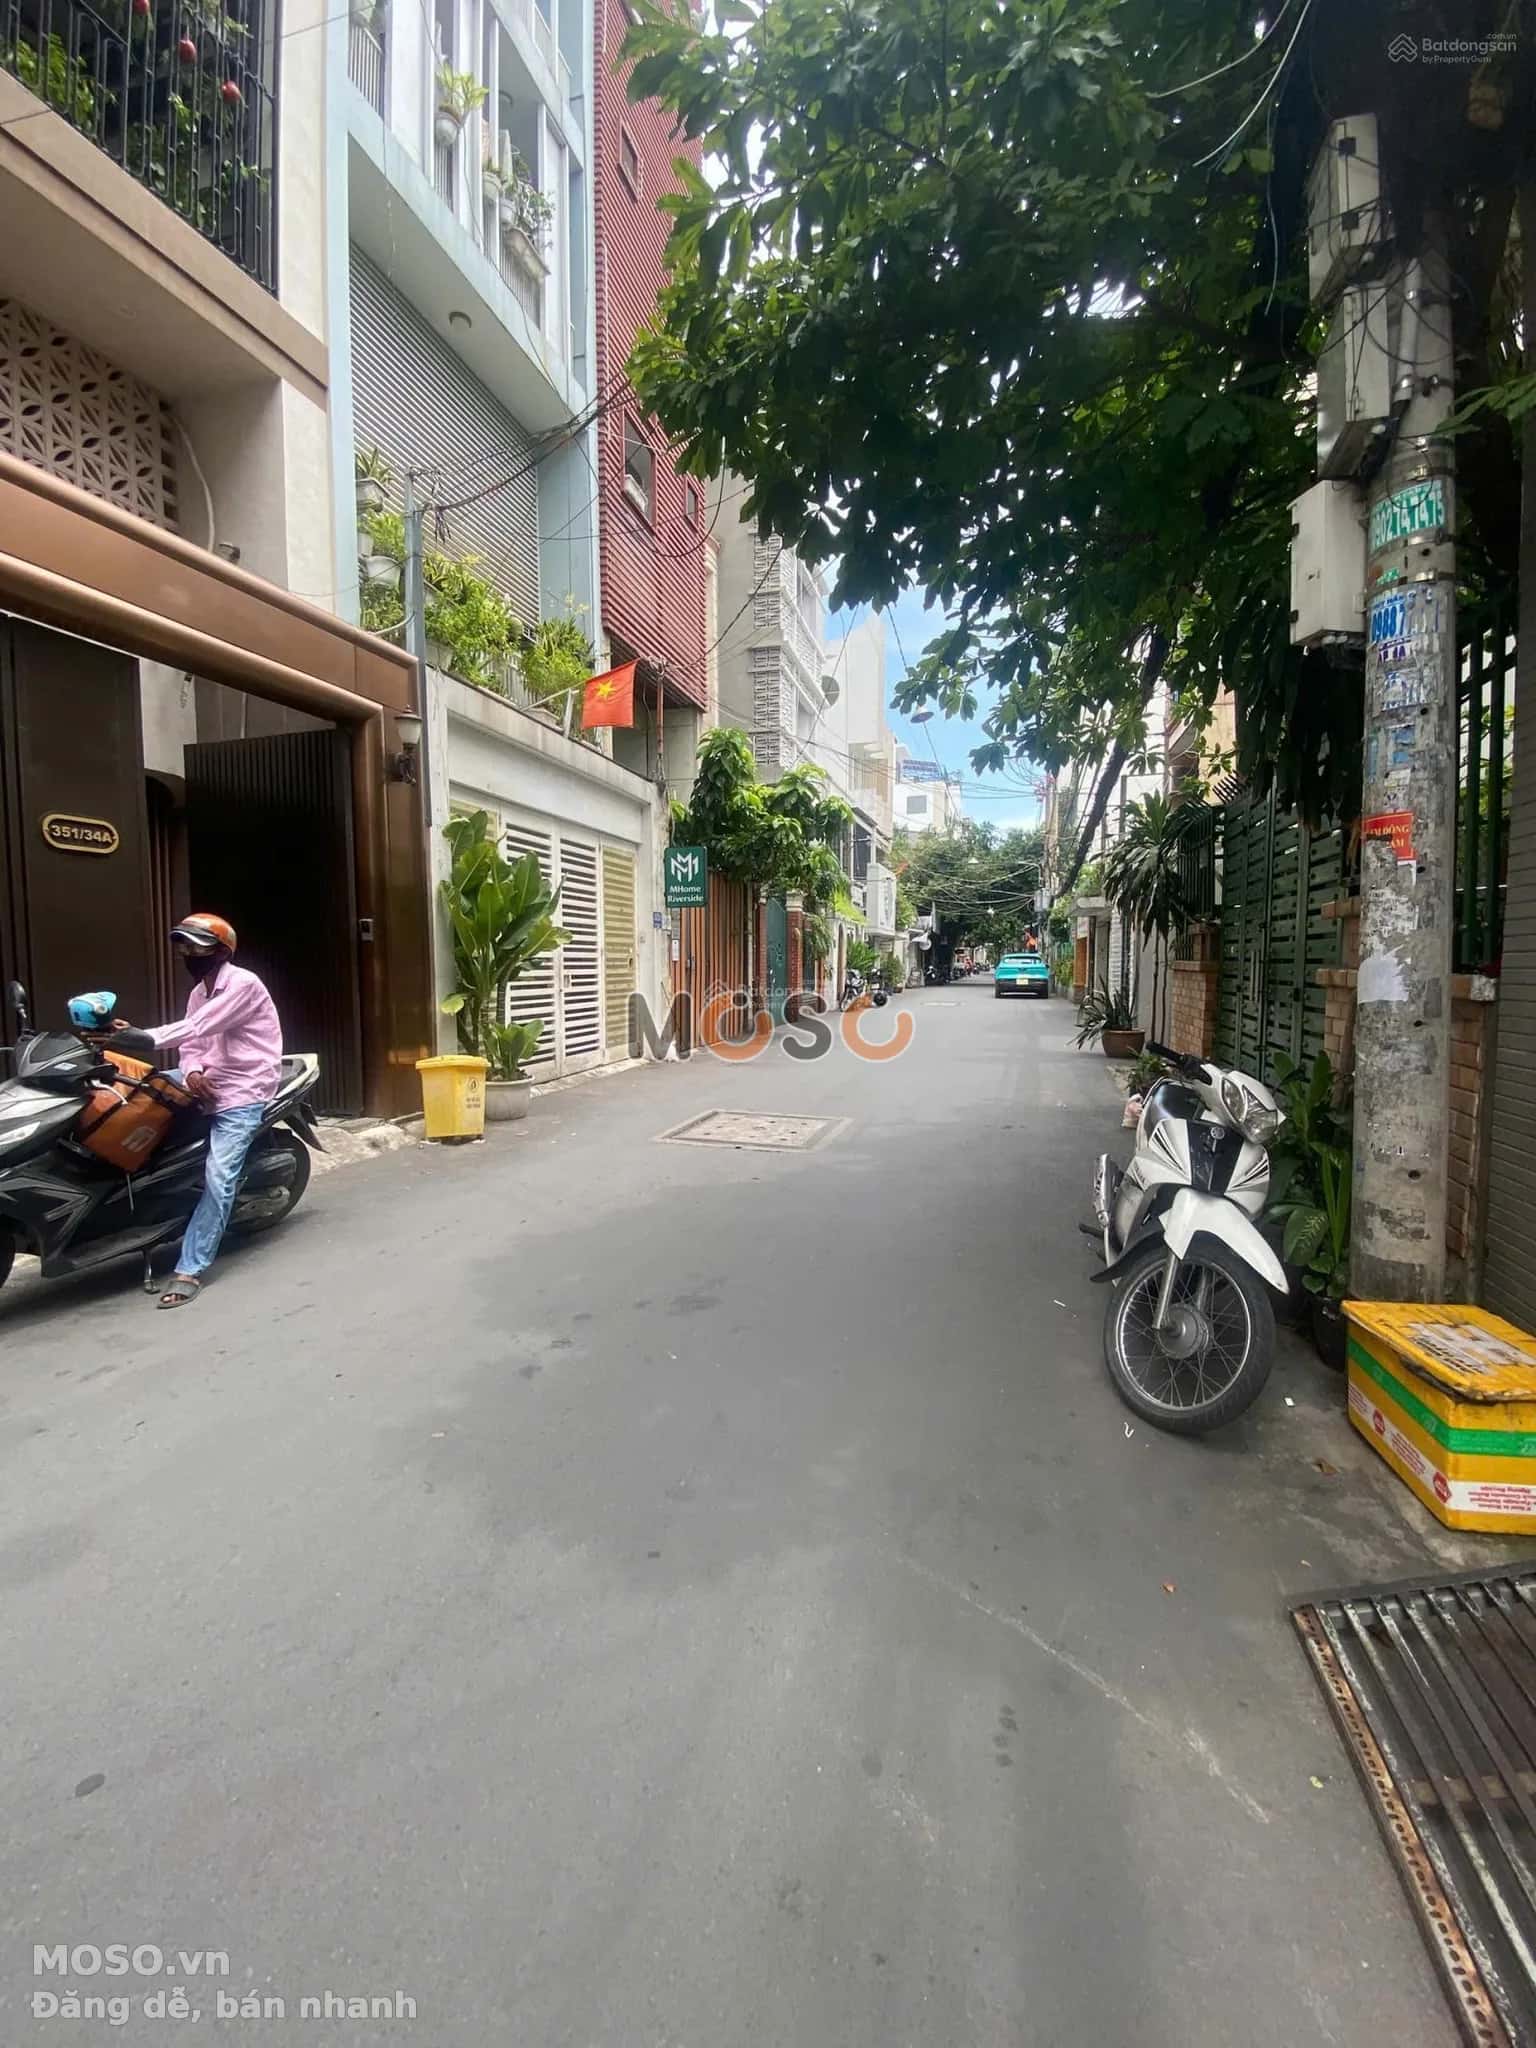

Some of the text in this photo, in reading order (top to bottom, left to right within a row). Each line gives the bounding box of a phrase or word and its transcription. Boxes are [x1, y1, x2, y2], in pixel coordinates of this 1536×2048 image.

[50, 824, 113, 844] 351/34A
[669, 885, 702, 894] MHome
[667, 894, 705, 903] Riverside
